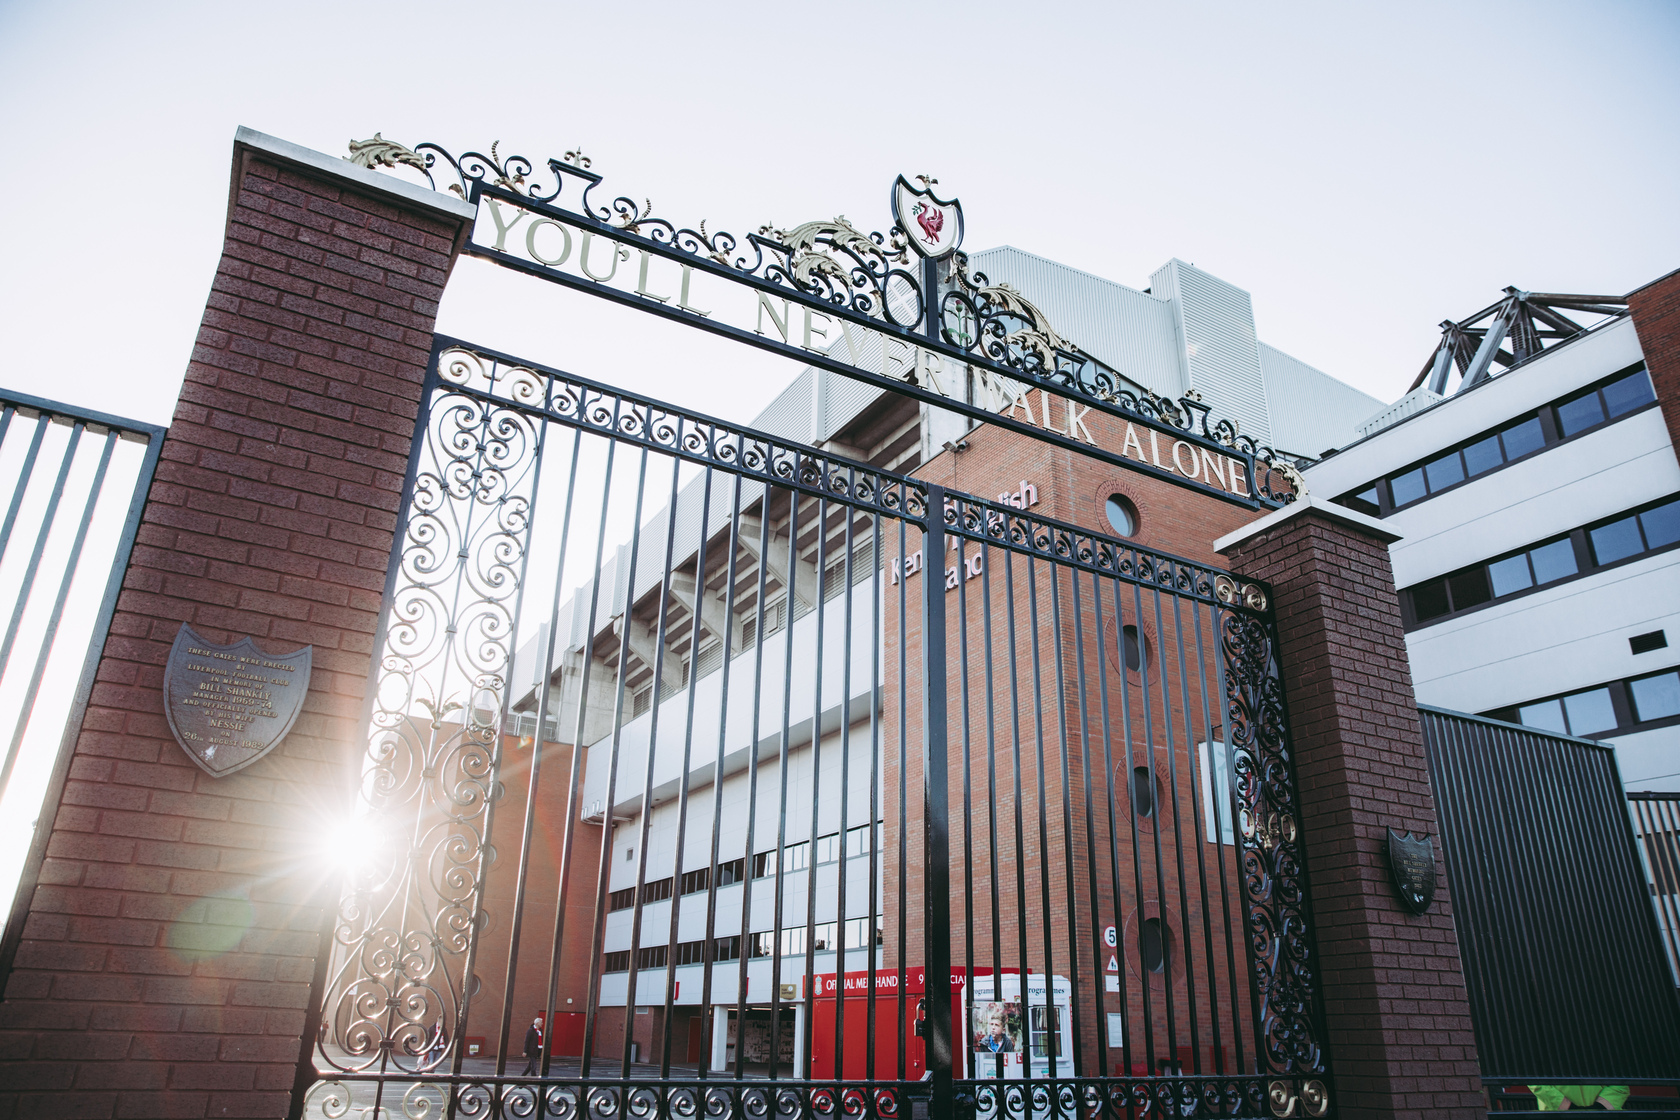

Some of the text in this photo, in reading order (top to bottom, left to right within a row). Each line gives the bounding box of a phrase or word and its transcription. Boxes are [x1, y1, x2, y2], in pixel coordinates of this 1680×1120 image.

[484, 198, 1250, 498] YOU'LL NEVER WALK ALONE
[188, 647, 296, 672] THESE GATES WERE ERECTED
[188, 663, 289, 686] LIVERPOOL FOOTBALL CLUB
[222, 678, 253, 688] MEMORY
[192, 691, 229, 703] MANAGER
[200, 682, 271, 700] BILL SHANKLY
[202, 702, 246, 713] OFFICIALLY
[249, 709, 278, 718] OPENED
[235, 714, 255, 723] WIFE
[209, 719, 245, 732] NESSIE
[209, 737, 238, 746] AUGUST
[241, 740, 265, 750] 1982
[1109, 930, 1115, 943] 5
[826, 978, 854, 990] OFIAL
[1028, 987, 1065, 996] rogrames
